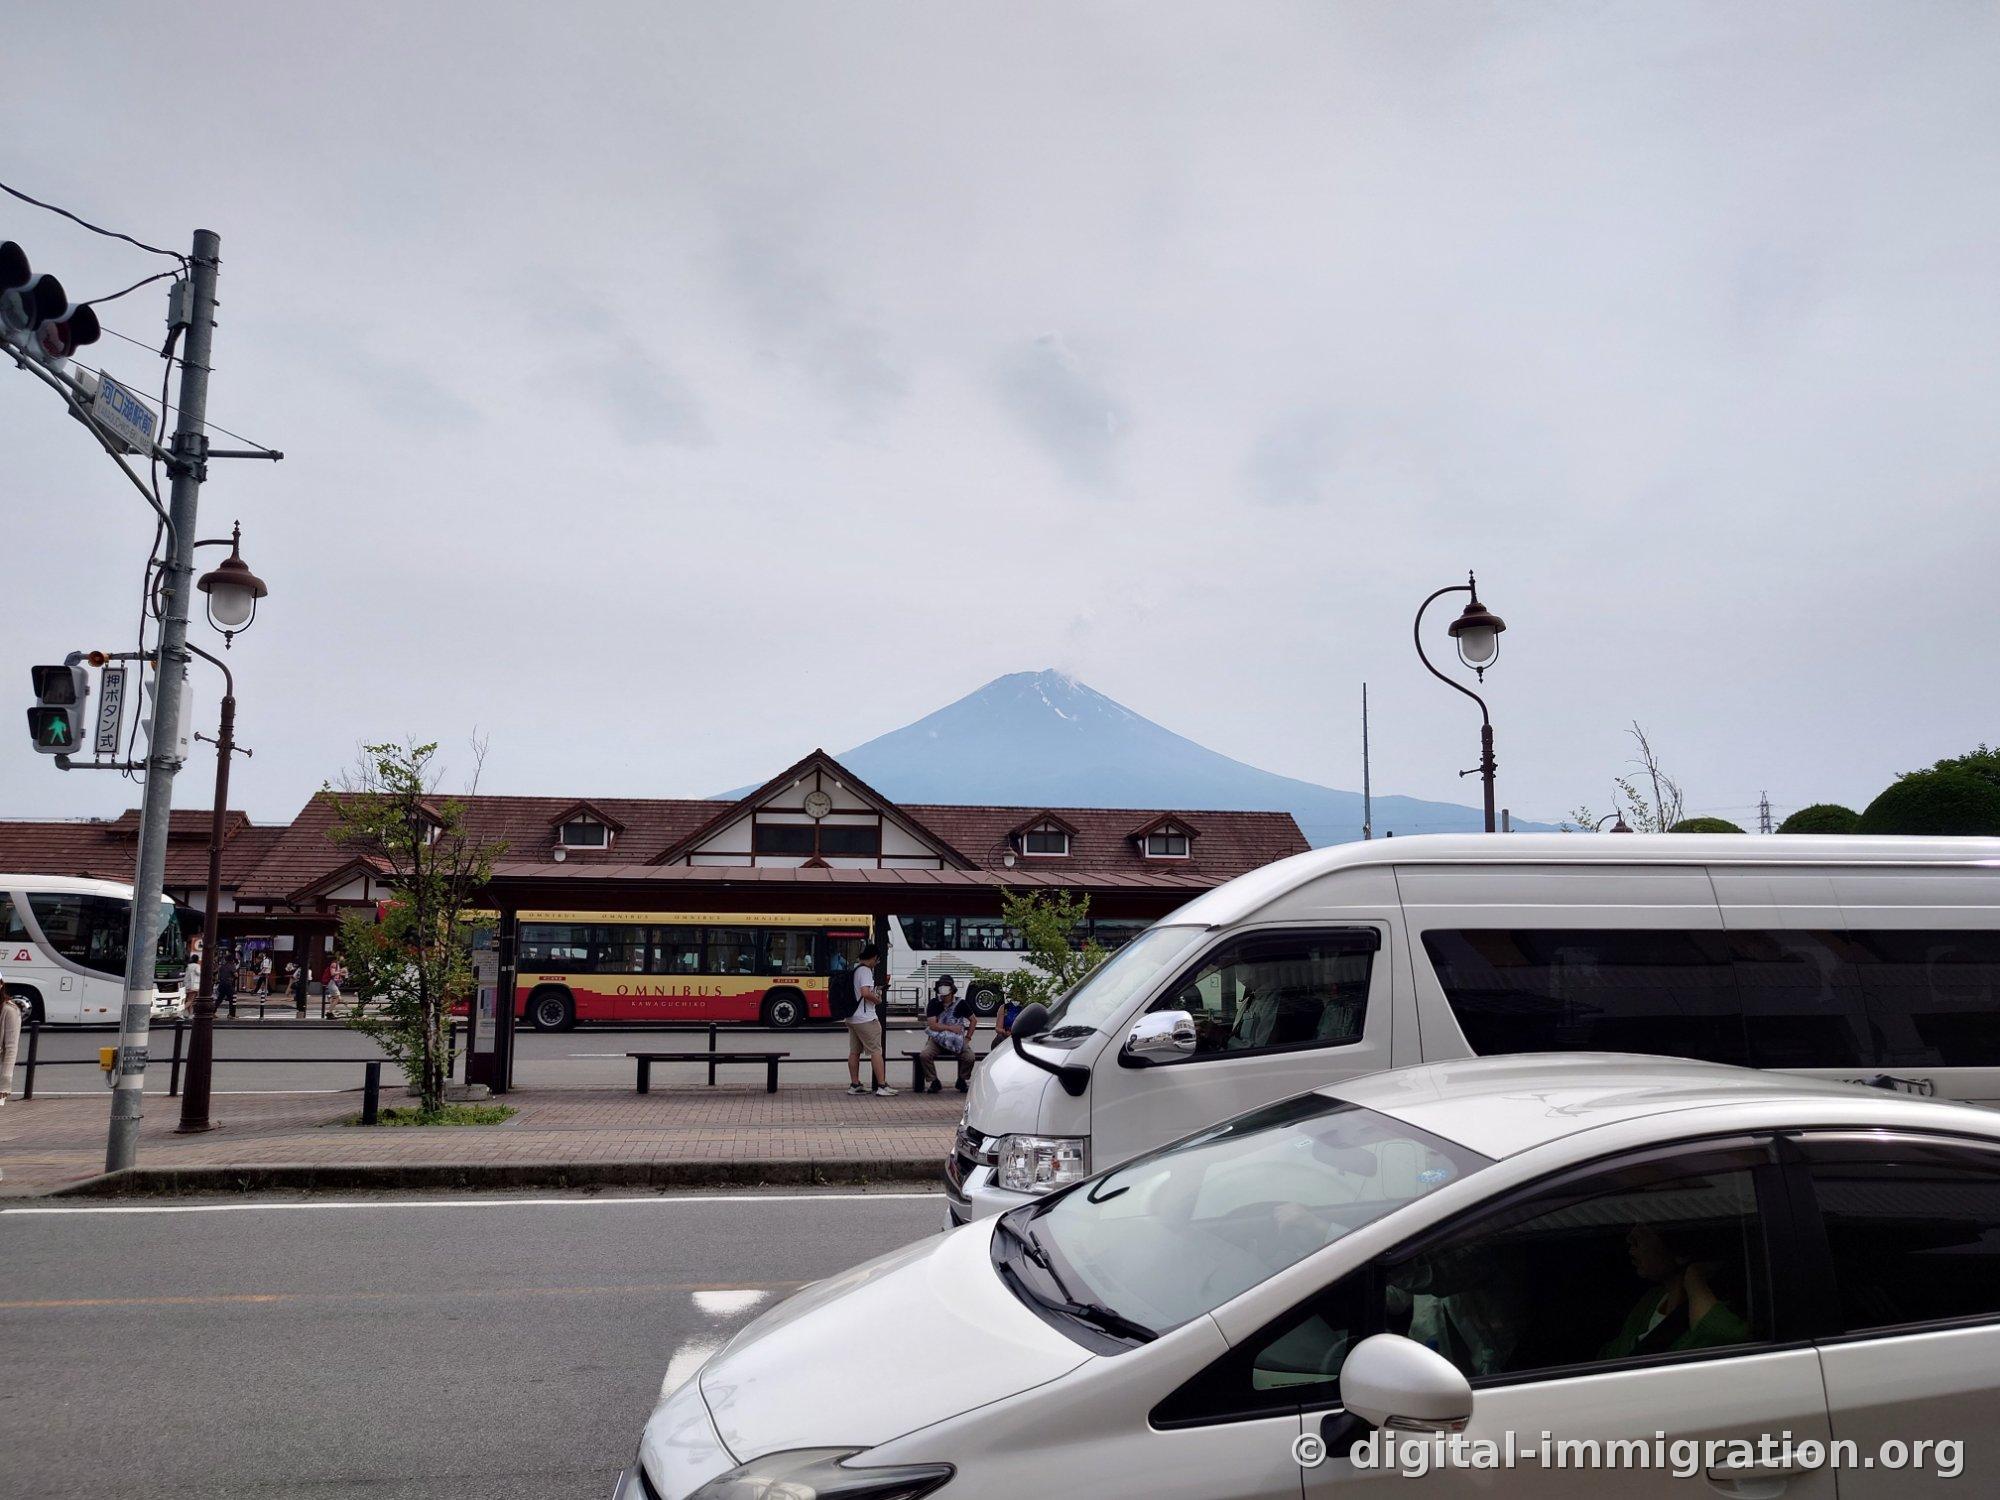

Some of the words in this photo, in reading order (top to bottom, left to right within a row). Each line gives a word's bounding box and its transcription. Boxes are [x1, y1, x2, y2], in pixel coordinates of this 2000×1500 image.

[101, 379, 153, 437] 河口湖駅前
[100, 674, 120, 747] 押ボタン式
[616, 984, 722, 996] OMNIBUS
